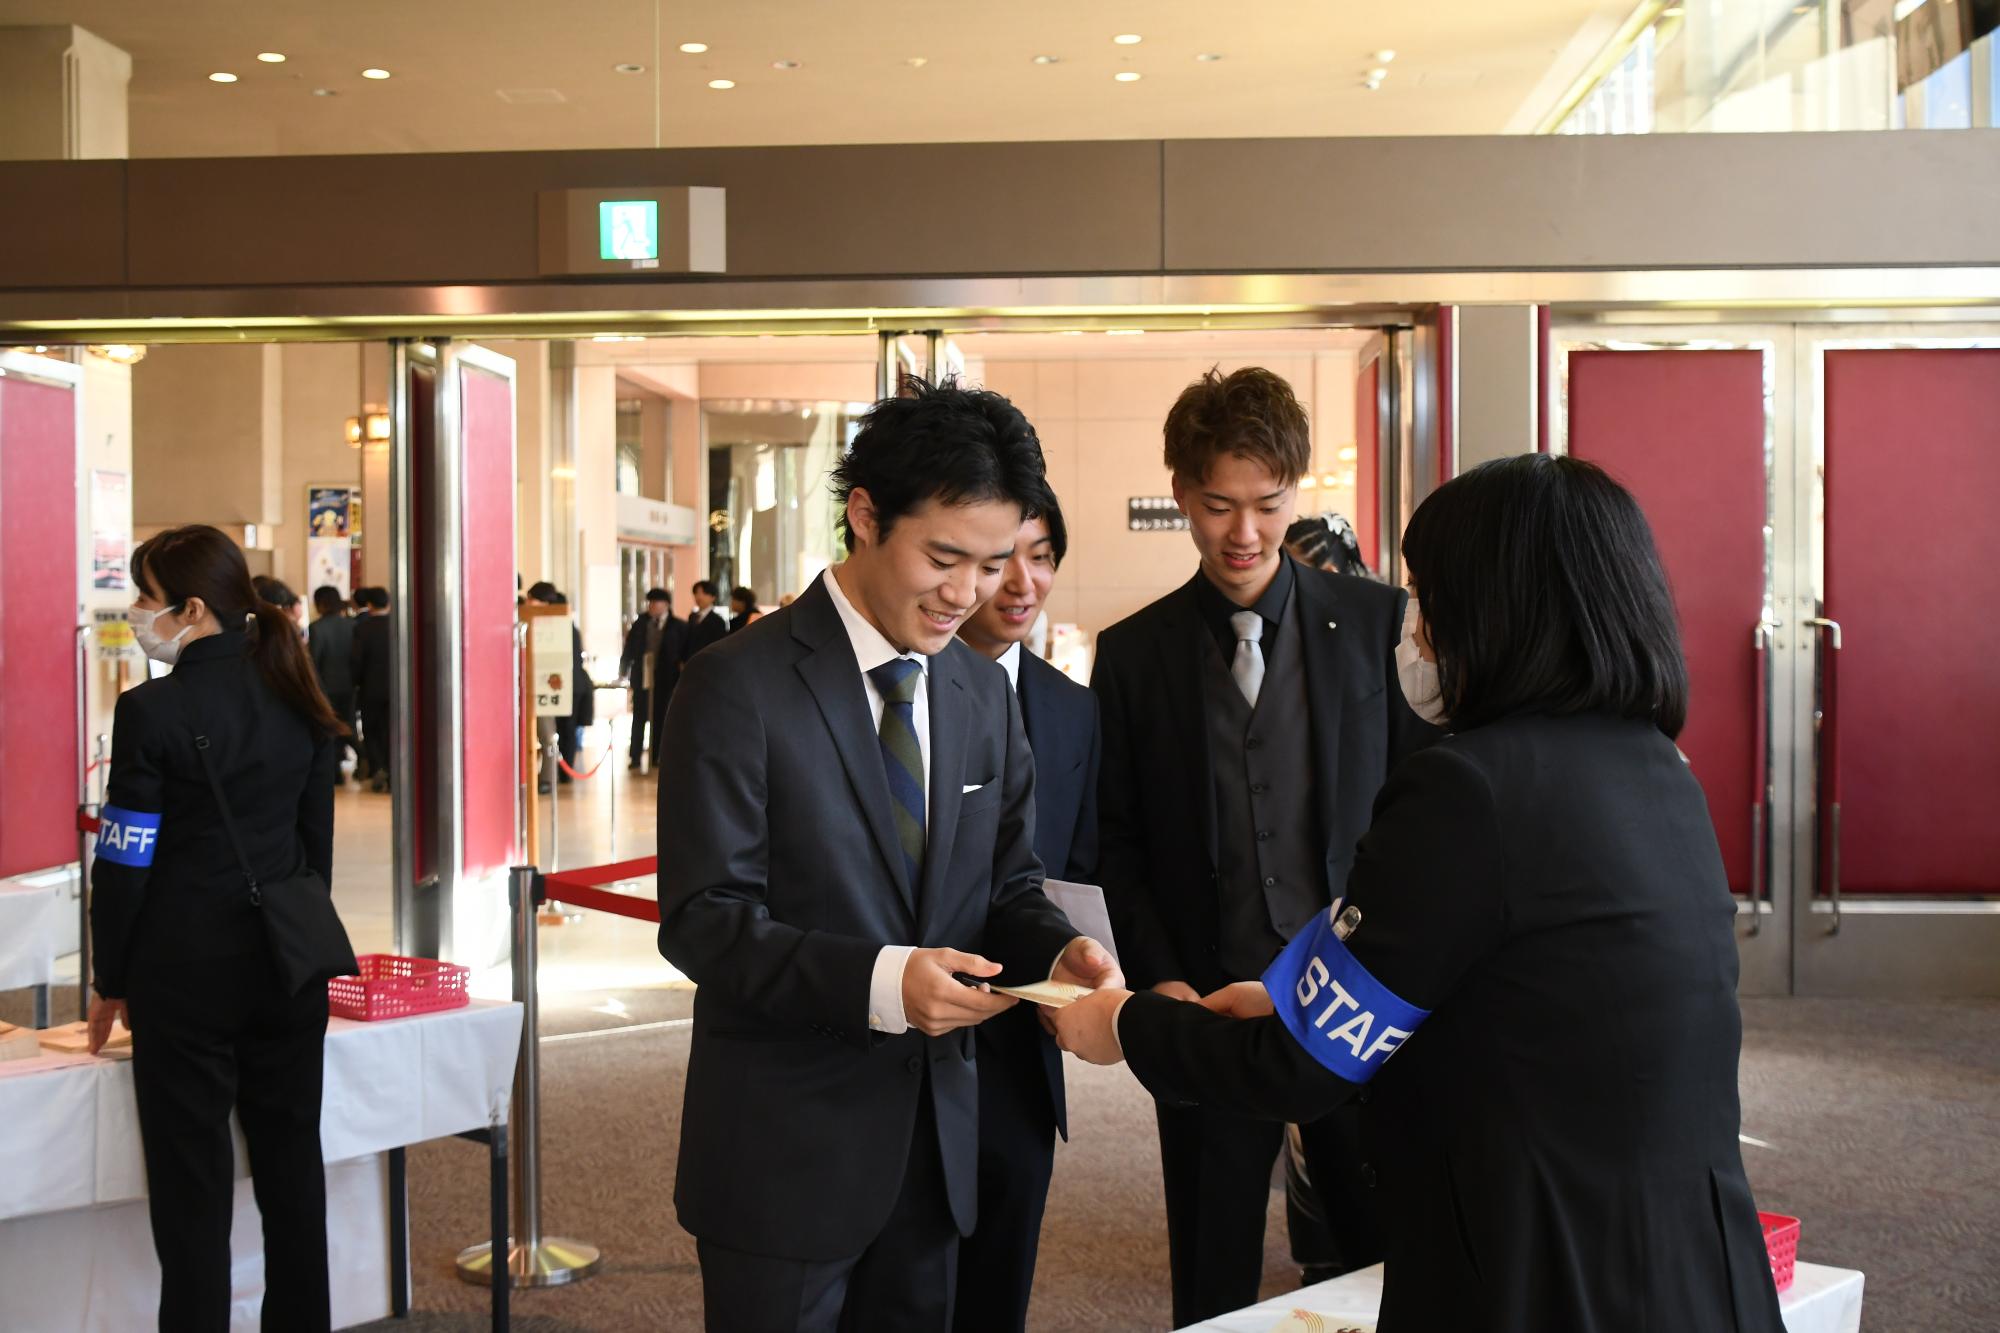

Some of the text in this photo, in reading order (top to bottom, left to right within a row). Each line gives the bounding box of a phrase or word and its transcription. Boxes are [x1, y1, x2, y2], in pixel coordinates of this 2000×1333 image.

[538, 694, 560, 706] です
[100, 818, 157, 854] TAFF
[1297, 956, 1414, 1064] STAF
